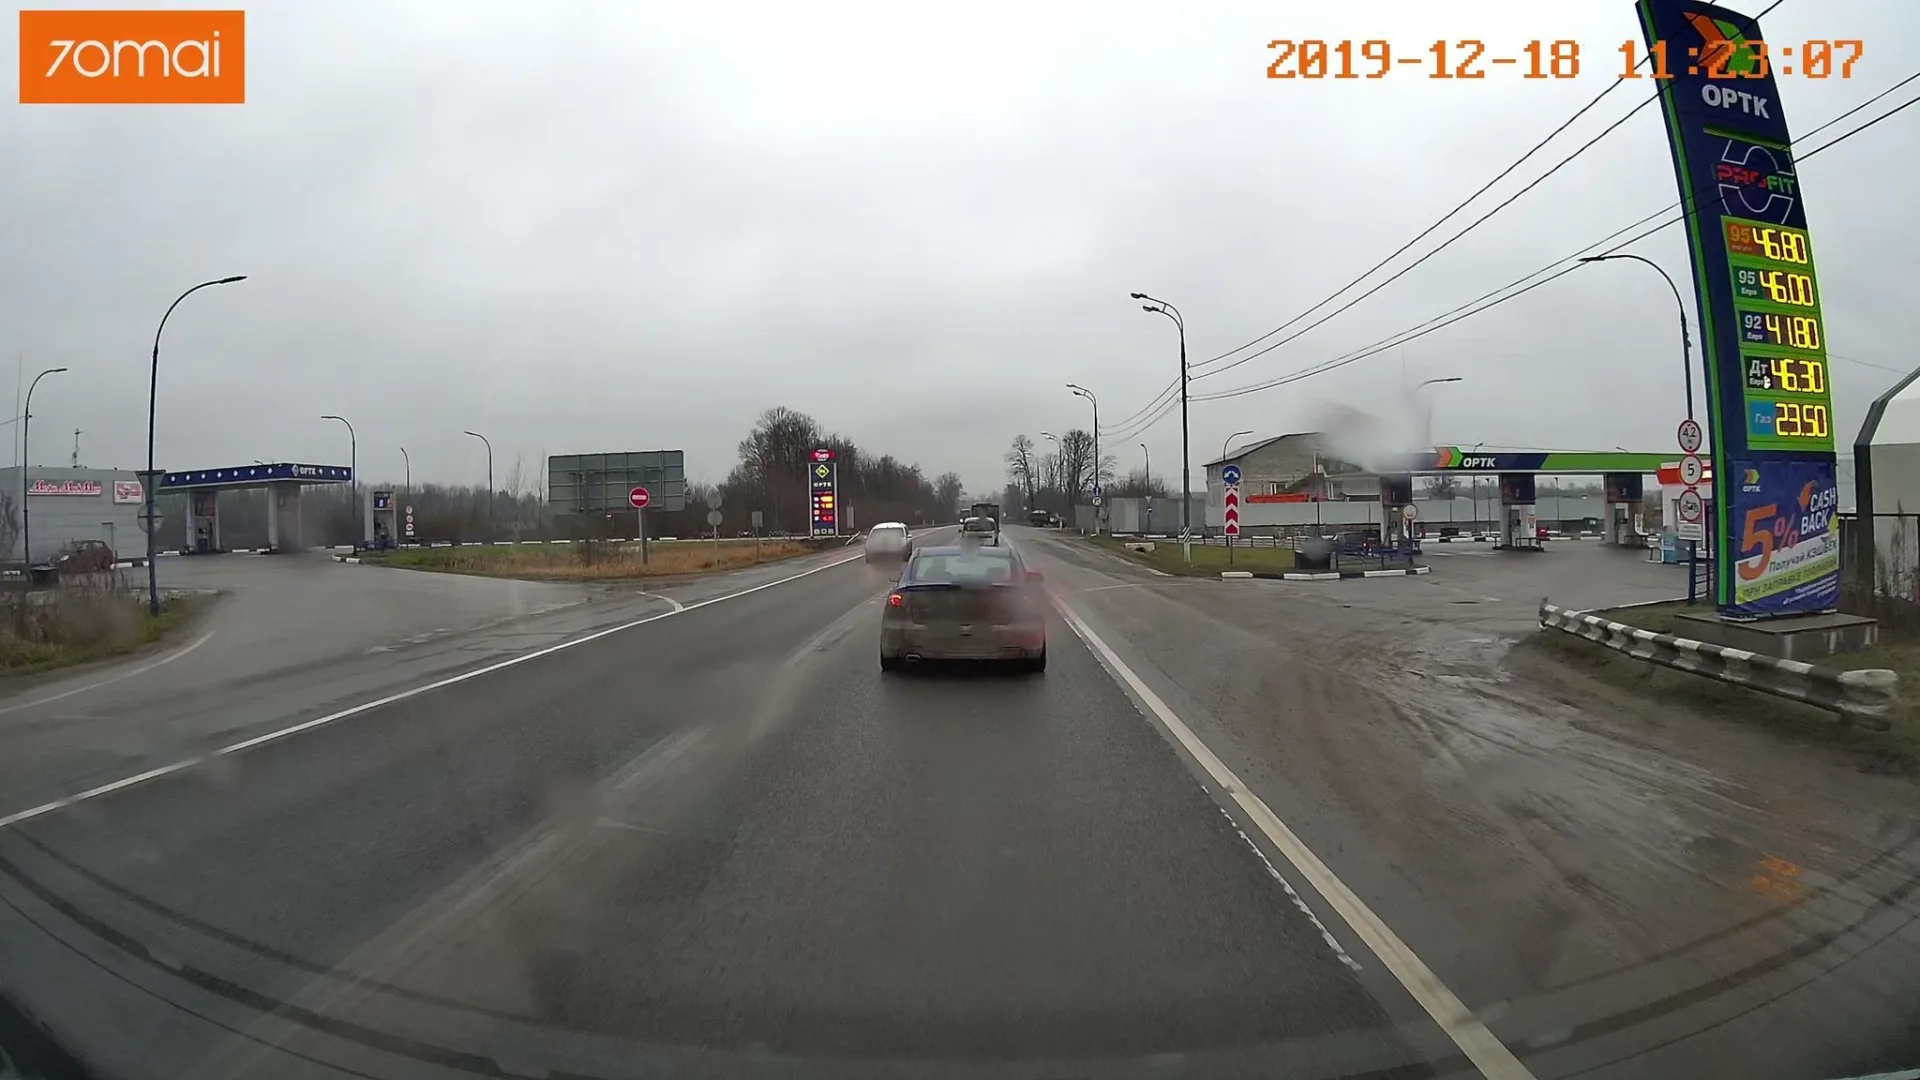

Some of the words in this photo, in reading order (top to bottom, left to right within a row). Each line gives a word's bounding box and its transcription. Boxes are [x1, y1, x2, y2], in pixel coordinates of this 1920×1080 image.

[1730, 224, 1751, 243] 95
[1752, 227, 1808, 264] 46.80
[1738, 270, 1756, 285] 95
[1760, 270, 1814, 306] 46.00
[1744, 314, 1762, 329] 92
[1765, 314, 1820, 349] 41.80
[1770, 358, 1825, 393] 46.30
[1755, 413, 1772, 424] Газ
[1775, 402, 1828, 437] 23.50
[1687, 463, 1695, 476] 5
[1809, 487, 1836, 513] CASH
[1801, 509, 1830, 535] BACK
